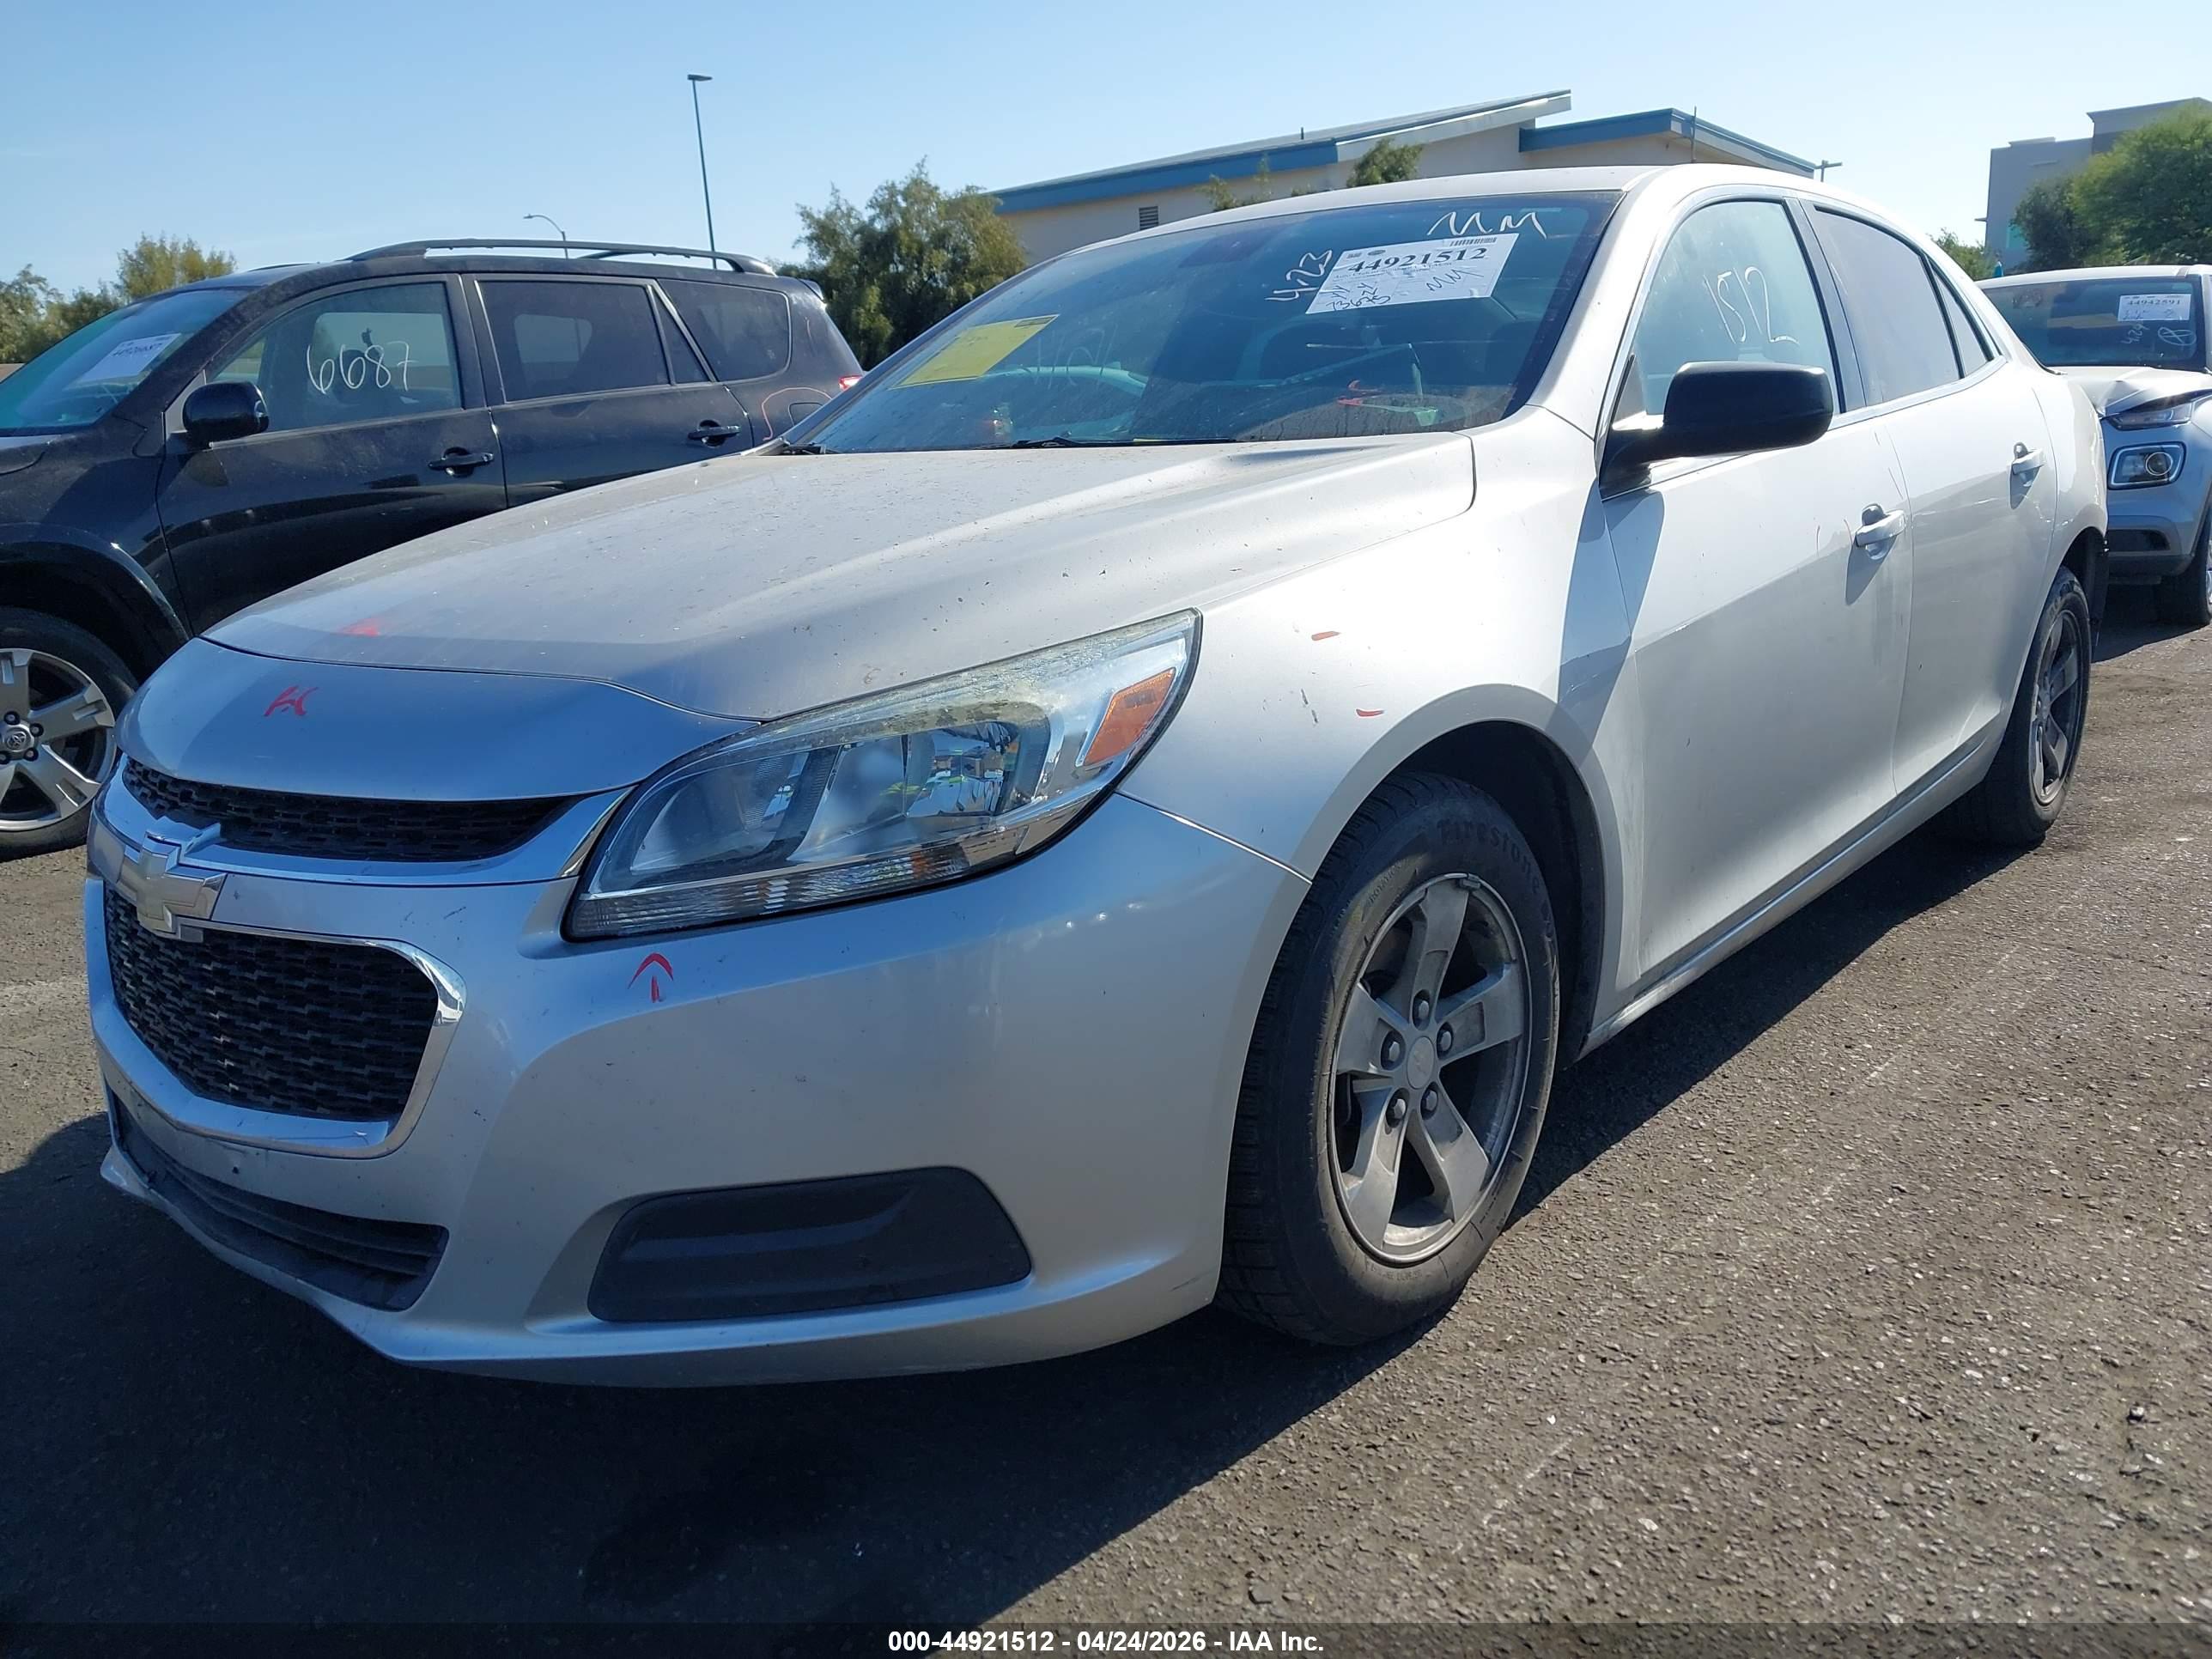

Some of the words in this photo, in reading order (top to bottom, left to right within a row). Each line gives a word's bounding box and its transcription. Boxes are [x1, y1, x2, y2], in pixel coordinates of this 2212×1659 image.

[1348, 246, 1488, 273] 44921512
[1703, 266, 1799, 344] 1512
[307, 340, 419, 395] 6687
